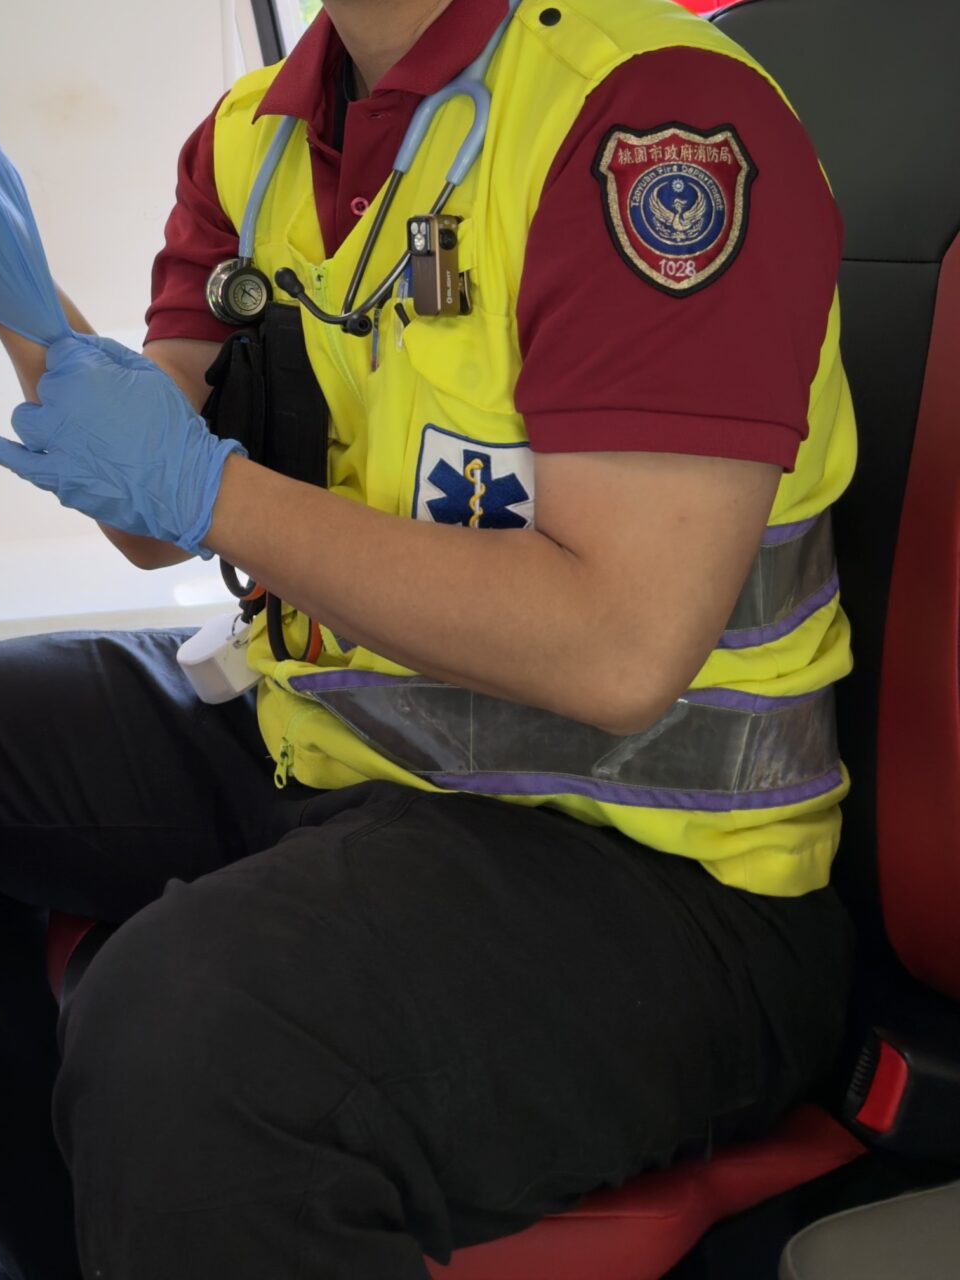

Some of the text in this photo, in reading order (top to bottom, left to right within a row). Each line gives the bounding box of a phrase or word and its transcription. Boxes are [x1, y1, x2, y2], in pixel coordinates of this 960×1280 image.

[618, 143, 732, 165] 桃園市政府消防局
[658, 259, 697, 278] 1028
